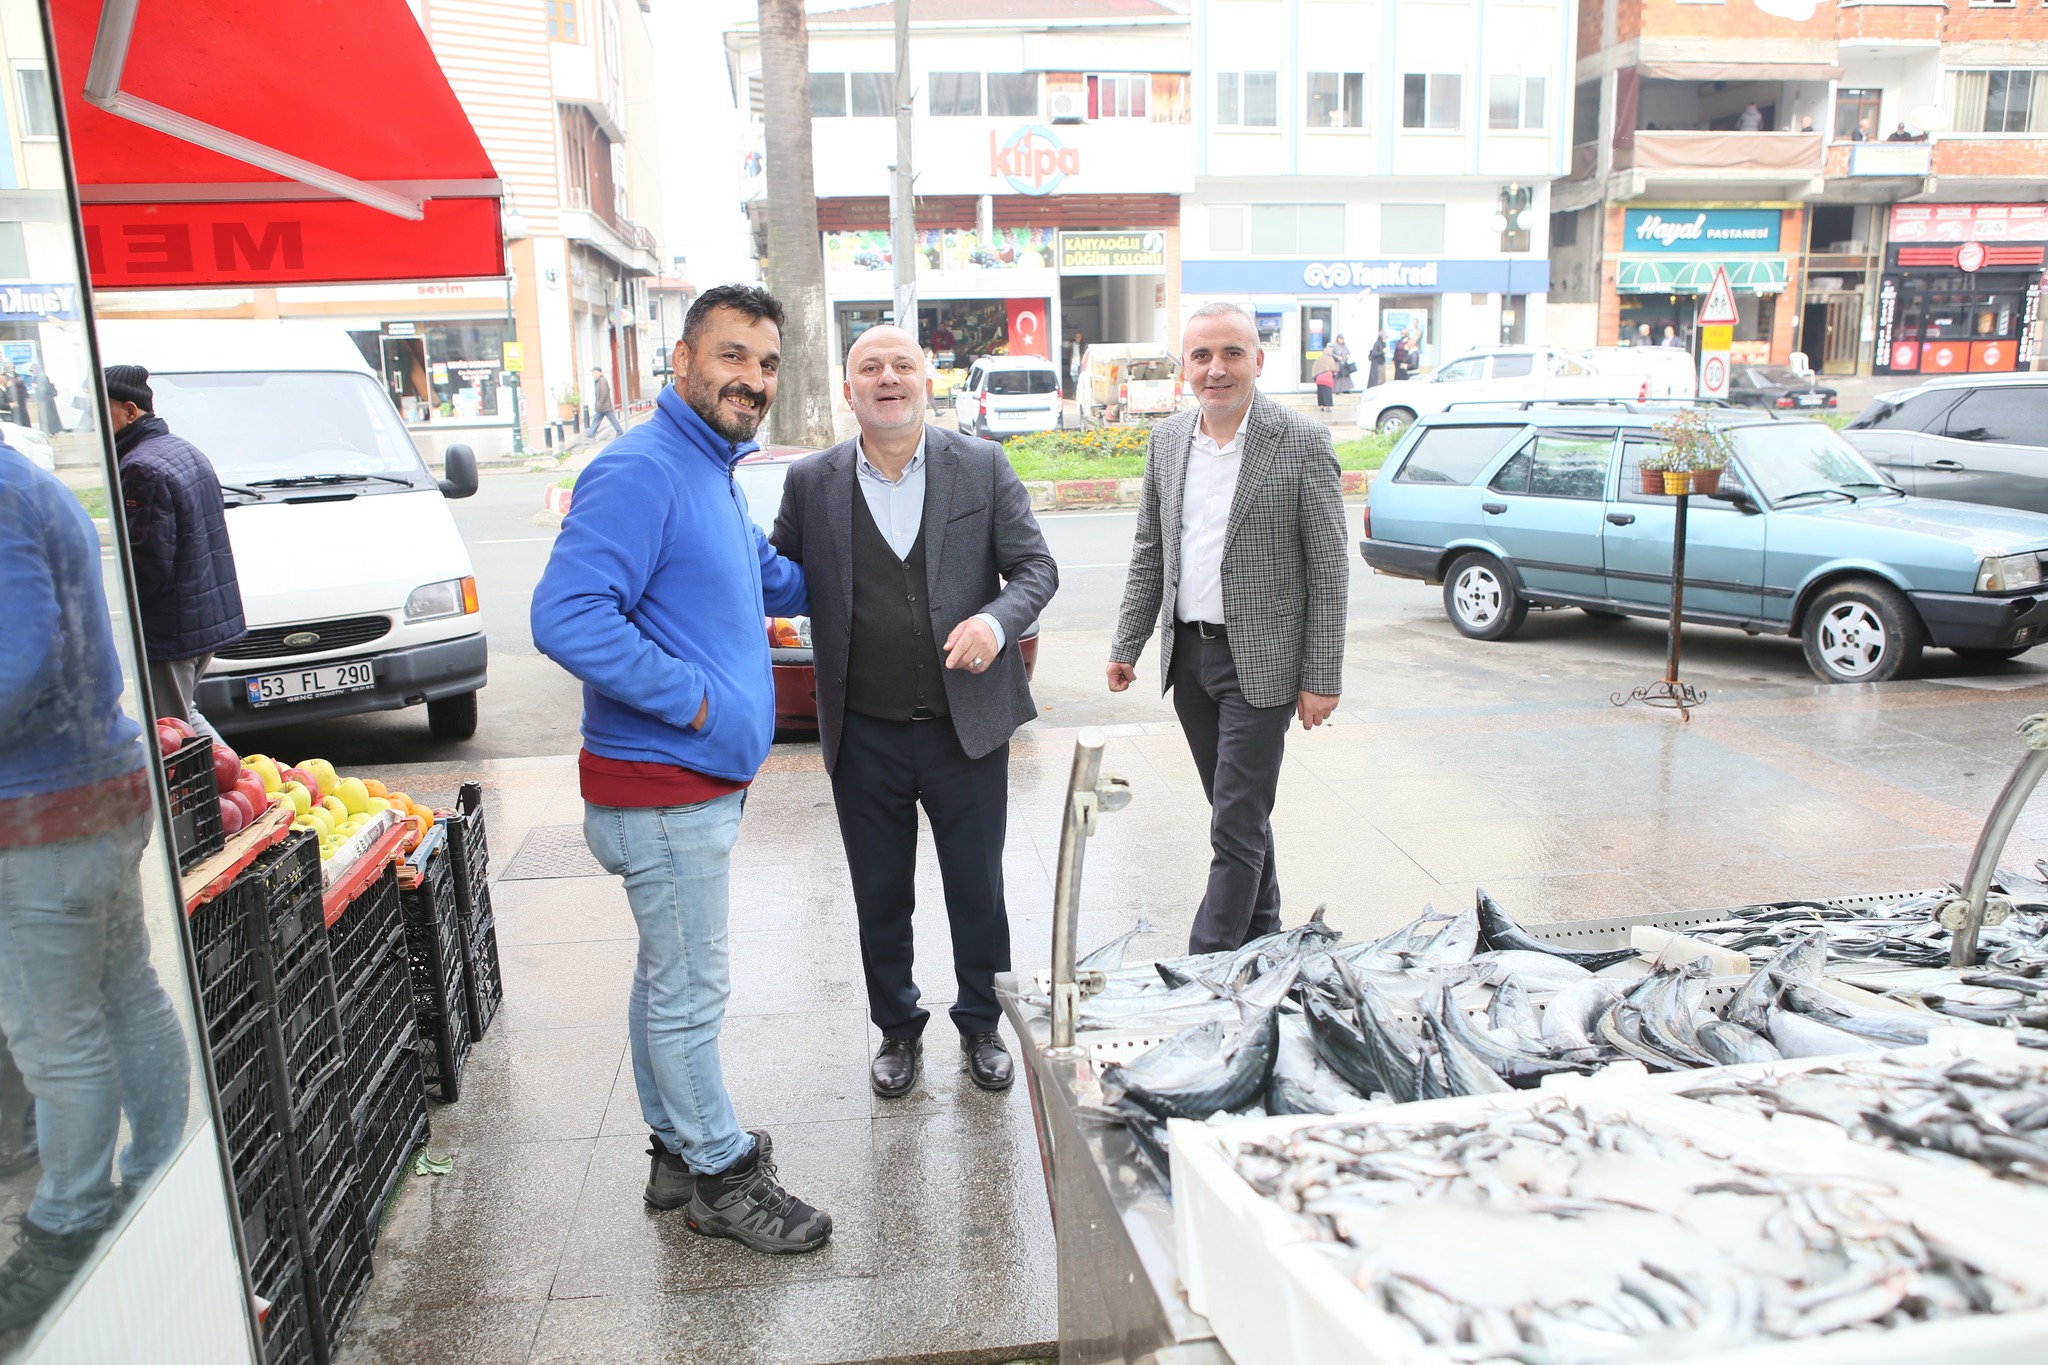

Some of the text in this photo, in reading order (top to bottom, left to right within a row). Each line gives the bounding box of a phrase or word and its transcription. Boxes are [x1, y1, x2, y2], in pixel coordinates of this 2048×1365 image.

[990, 128, 1079, 190] kilpa
[1636, 213, 1768, 246] Hayal PASTANESİ
[1064, 236, 1140, 250] KÂHYAOĞLU
[1065, 251, 1162, 266] DÜĞÜN SALONU
[1350, 261, 1438, 289] YapıKredi
[417, 282, 464, 294] sevim
[1709, 366, 1721, 382] 30
[260, 664, 371, 698] 53 FL 290
[250, 690, 260, 698] TR
